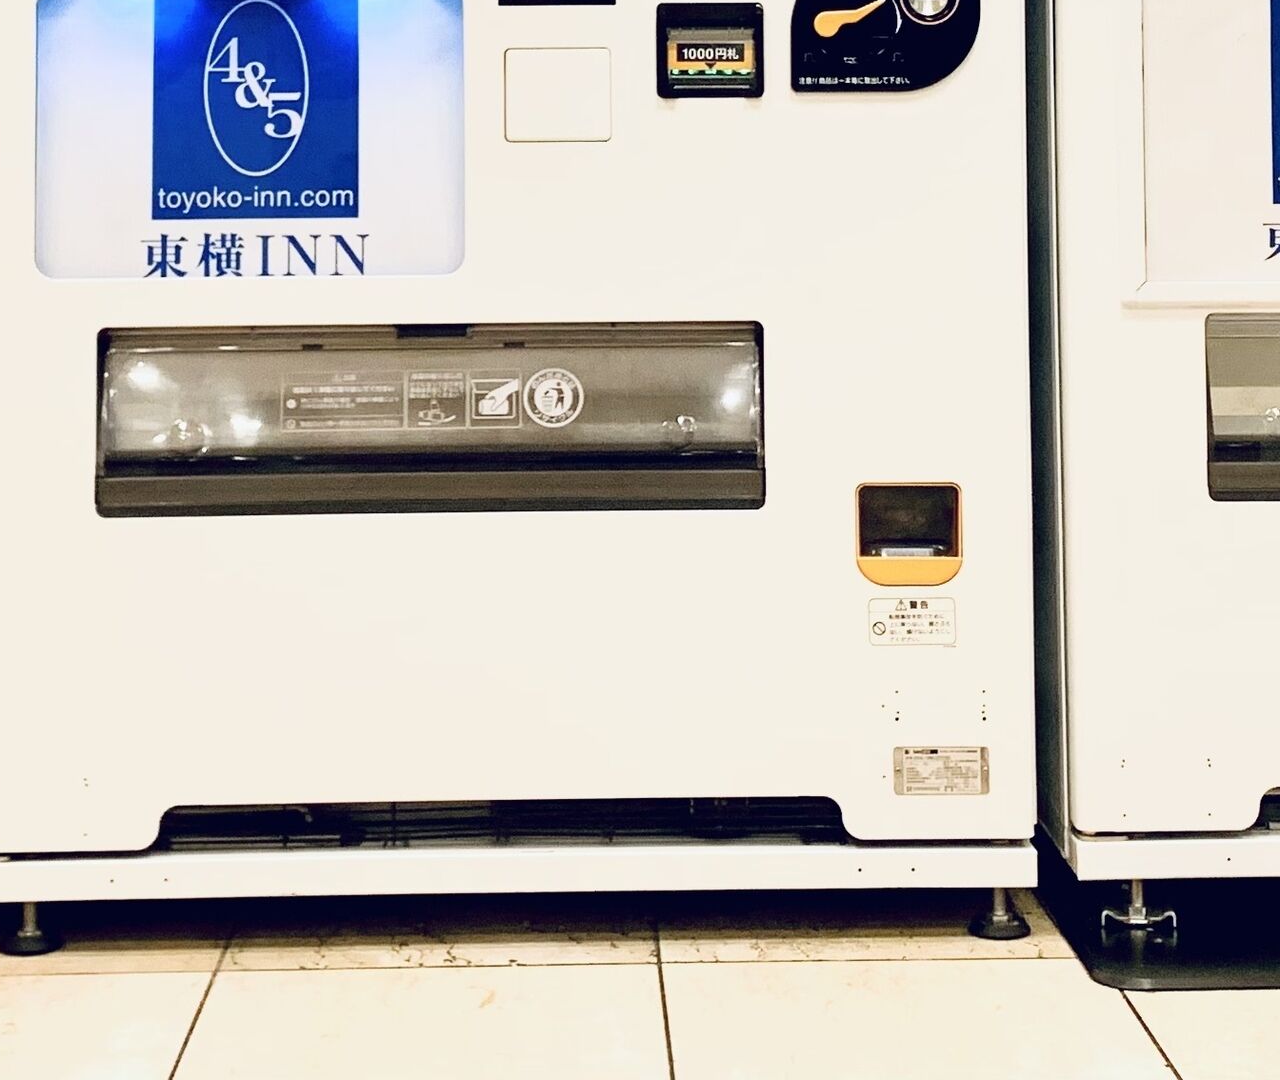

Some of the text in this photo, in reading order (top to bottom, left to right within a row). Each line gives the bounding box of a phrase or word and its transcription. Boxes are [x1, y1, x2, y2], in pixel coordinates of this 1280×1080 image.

[682, 47, 739, 61] 1000円札
[158, 185, 354, 214] toyoko-inn.com
[140, 233, 369, 278] 東横INN
